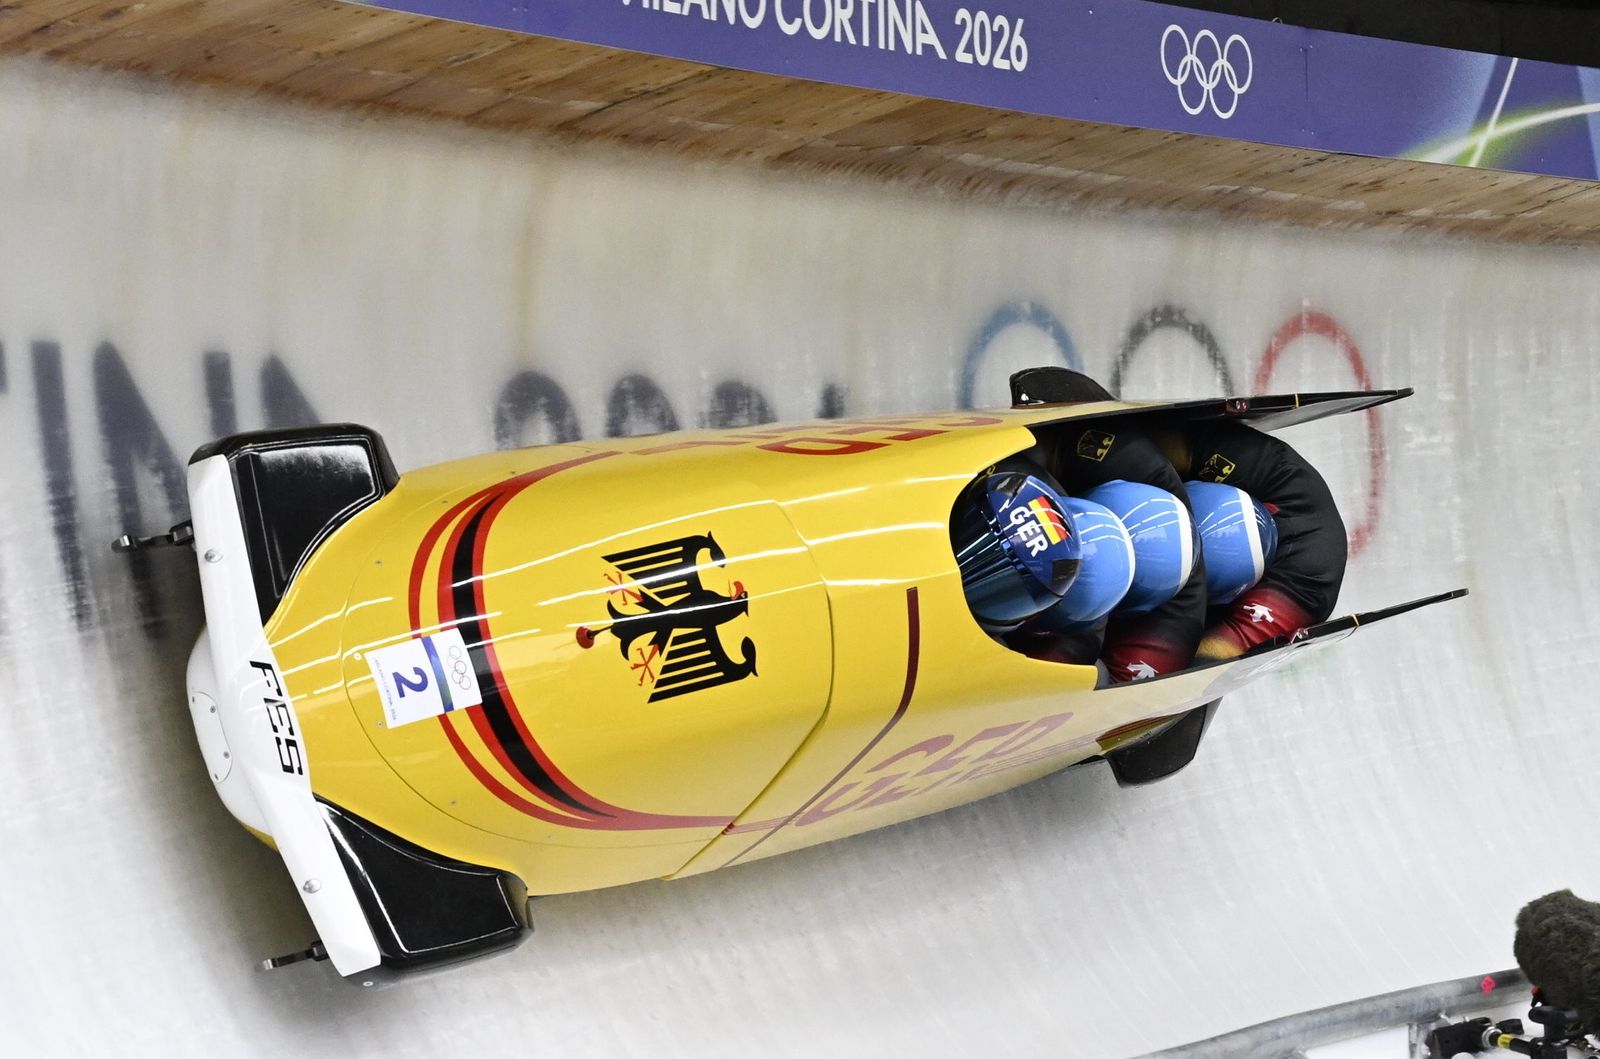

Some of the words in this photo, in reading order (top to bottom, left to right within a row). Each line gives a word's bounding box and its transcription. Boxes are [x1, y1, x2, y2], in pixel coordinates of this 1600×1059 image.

[774, 0, 948, 60] CORTINA
[954, 9, 1028, 72] 2026
[1009, 505, 1049, 558] GER
[392, 667, 428, 699] 2
[249, 660, 304, 776] FES
